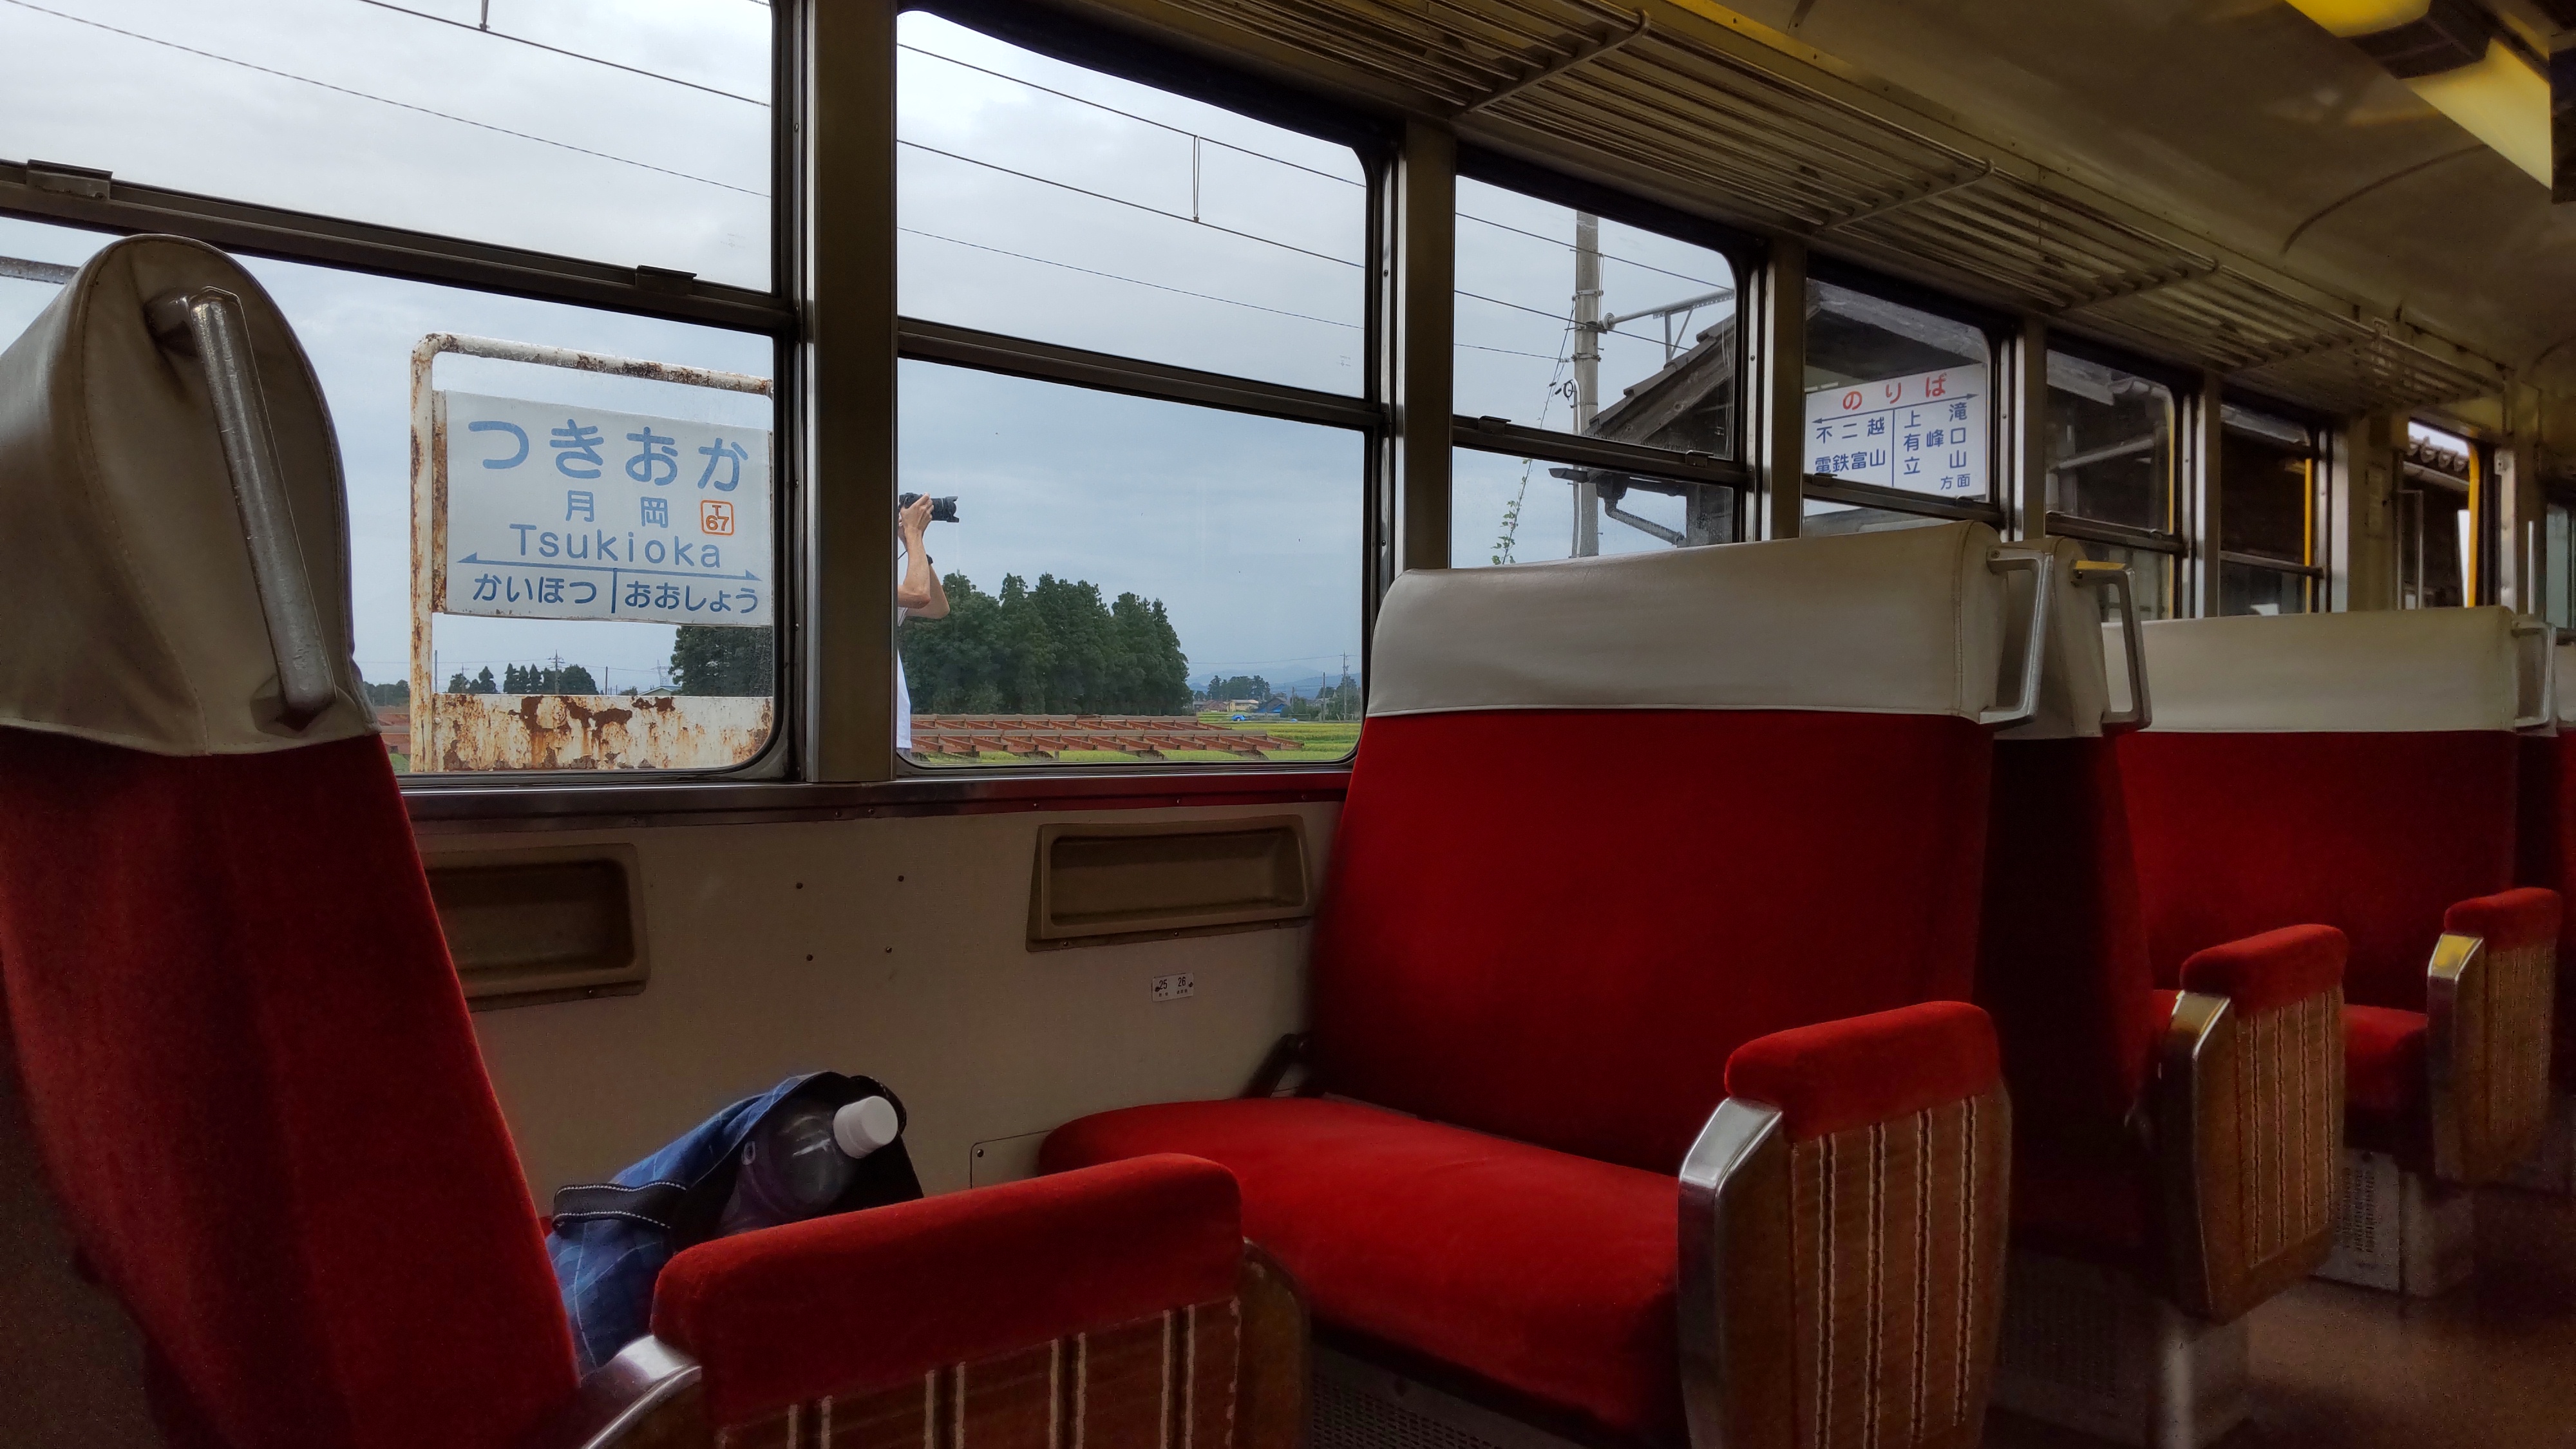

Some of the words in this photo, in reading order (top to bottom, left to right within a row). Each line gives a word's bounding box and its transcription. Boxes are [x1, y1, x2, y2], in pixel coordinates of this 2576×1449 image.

[1842, 373, 1947, 410] のりば
[1904, 402, 1967, 428] 上滝
[1816, 417, 1884, 444] 不二越
[1903, 427, 1966, 452] 有峰口
[468, 419, 748, 491] つきおか
[1815, 449, 1886, 473] 電鉄富山
[1904, 450, 1967, 475] 立山
[1940, 473, 1970, 490] 方面
[565, 489, 668, 528] 月岡
[706, 515, 729, 531] 67
[509, 524, 721, 568] Tsukioka
[473, 573, 597, 604] かいほつ
[625, 581, 759, 614] おおしょう
[1159, 979, 1167, 990] 25
[1178, 977, 1186, 987] 26
